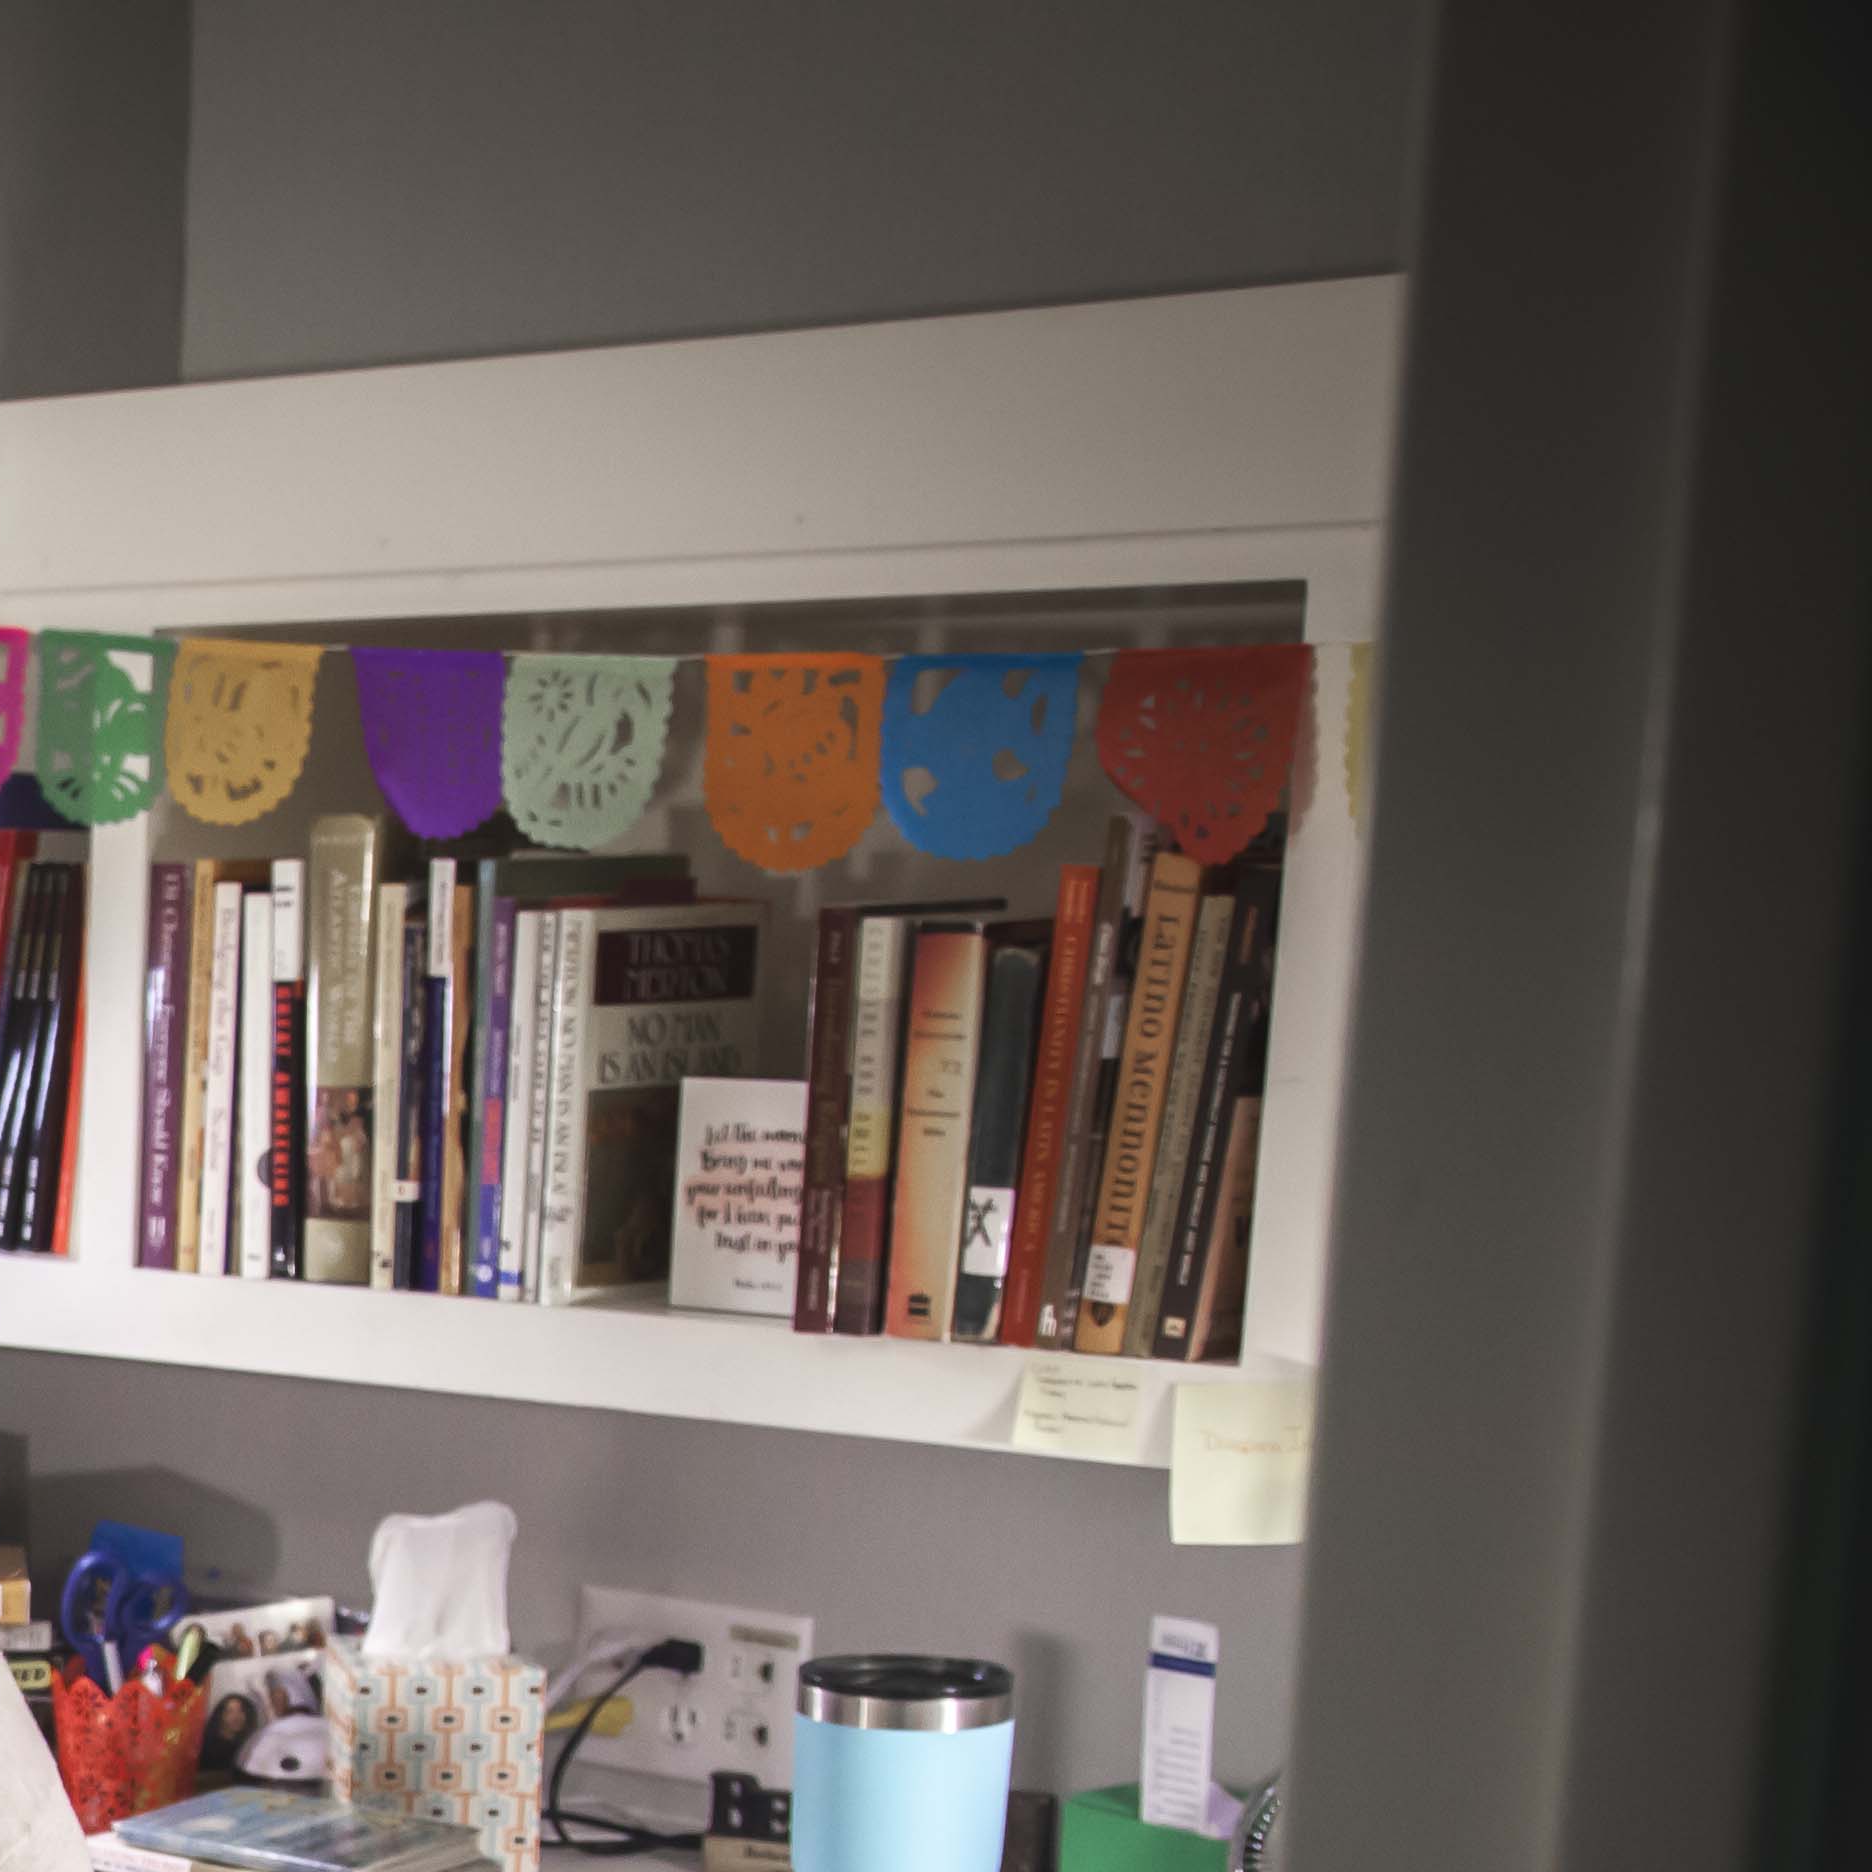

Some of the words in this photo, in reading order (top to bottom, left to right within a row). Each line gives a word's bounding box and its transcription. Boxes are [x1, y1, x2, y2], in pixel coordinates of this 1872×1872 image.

[273, 986, 293, 1057] GREAT
[627, 1011, 670, 1046] NO
[672, 1009, 722, 1044] MAN
[1049, 933, 1078, 1072] CHRISTIANITY
[597, 1051, 622, 1086] IS
